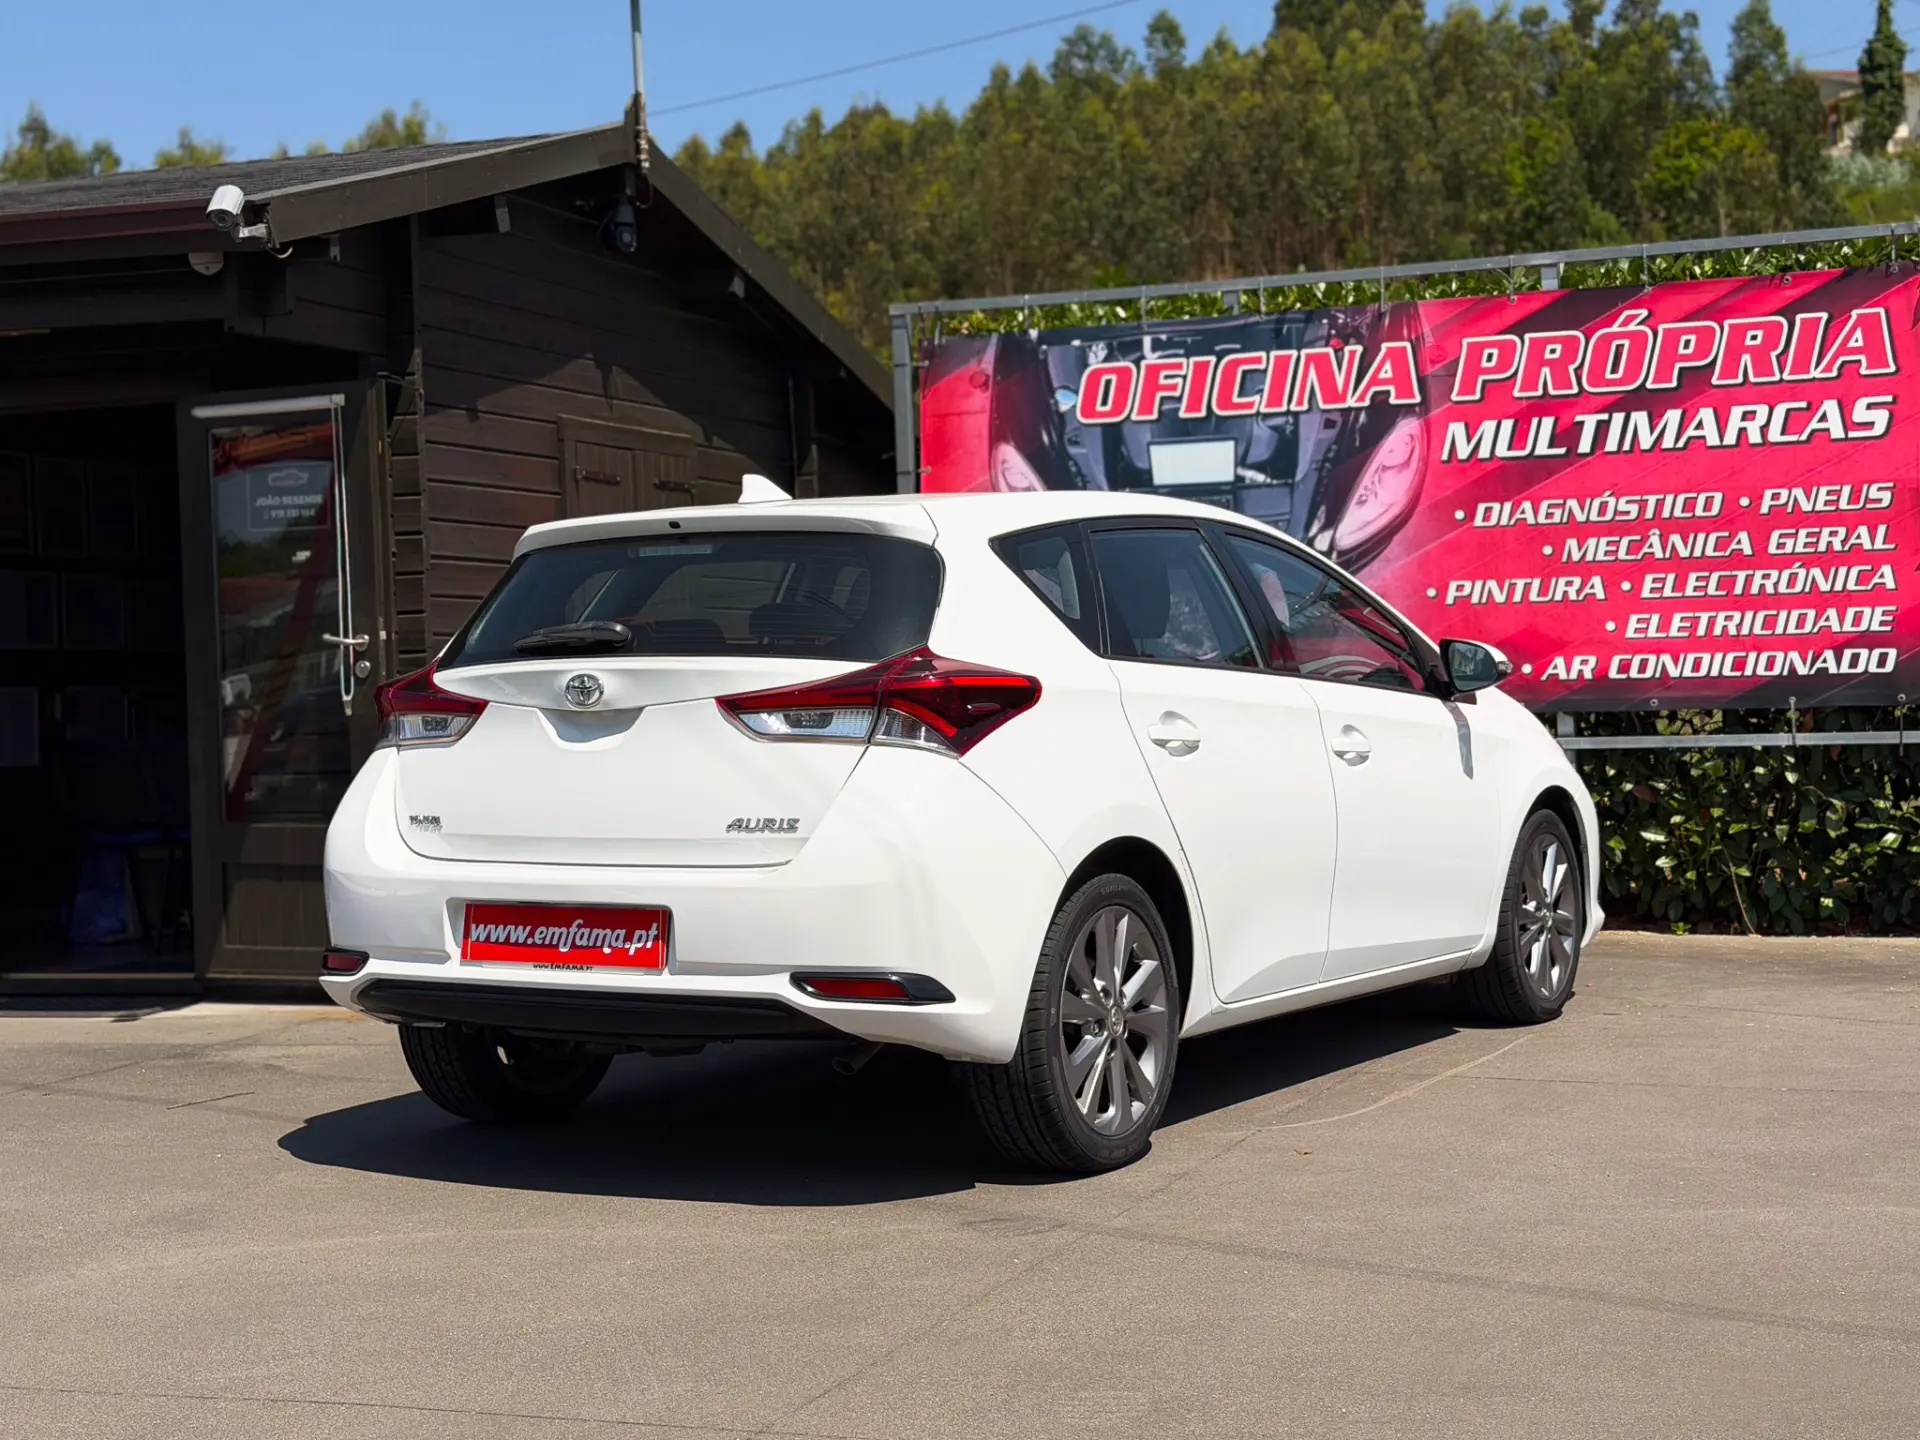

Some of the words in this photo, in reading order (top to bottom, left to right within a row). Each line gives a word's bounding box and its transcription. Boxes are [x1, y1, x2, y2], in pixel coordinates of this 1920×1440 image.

[1076, 341, 1422, 424] OFICINA
[1450, 307, 1897, 401] PRÓPRIA
[1440, 395, 1893, 461] MULTIMARCAS
[1473, 491, 1723, 528] DIAGNÓSTICO
[1759, 482, 1895, 514] PNEUS
[1562, 529, 1753, 563] MECÂNICA
[1767, 524, 1896, 555] GERAL
[1445, 575, 1606, 605] PINTURA
[1640, 562, 1897, 599] ELECTRÓNICA
[1625, 605, 1898, 639] ELETRICIDADE
[1540, 655, 1597, 681] AR
[1608, 648, 1898, 680] CONDICIONADO
[725, 817, 801, 833] AURIS
[471, 919, 659, 955] www.emfama.pt
